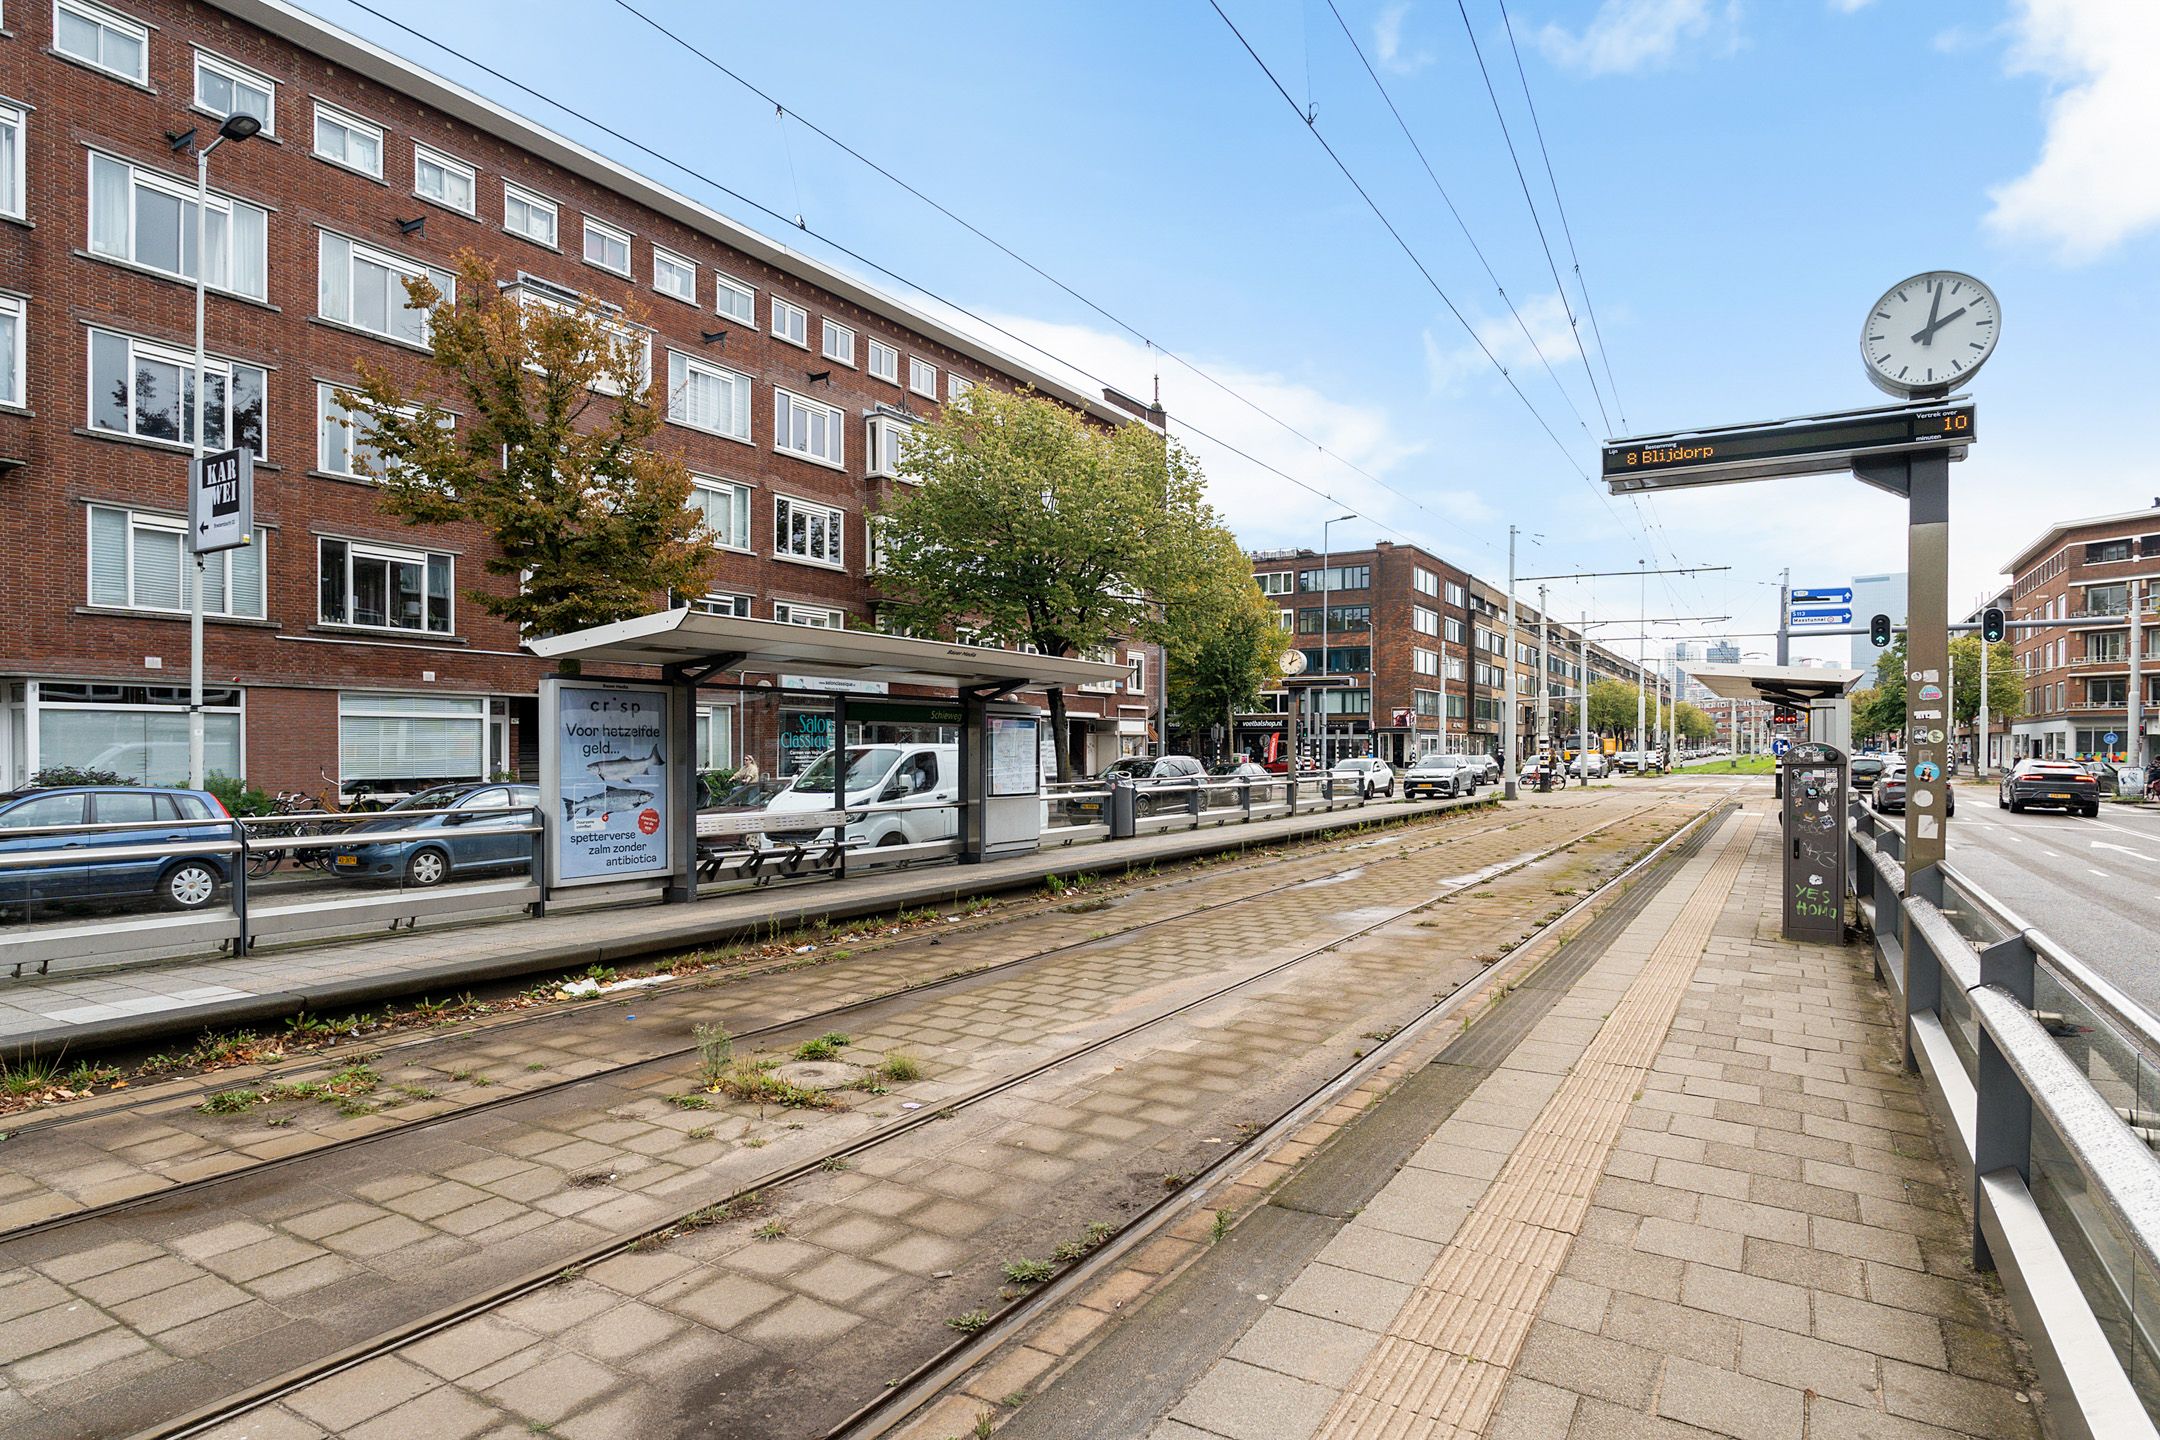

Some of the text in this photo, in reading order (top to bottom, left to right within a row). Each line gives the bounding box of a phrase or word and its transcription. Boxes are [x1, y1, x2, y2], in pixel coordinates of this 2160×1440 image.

[1944, 415, 1967, 431] 10
[1915, 434, 1942, 442] minuten
[1627, 447, 1714, 465] 8 Blijdorp
[206, 458, 237, 486] KAR
[212, 480, 237, 506] WEI
[799, 714, 833, 733] Salon
[930, 710, 963, 722] Schieweg
[1242, 719, 1283, 728] voetbalshop.nl
[565, 722, 661, 738] Voor hetzelfde
[582, 741, 620, 758] geld...
[570, 832, 636, 845] spetterverse
[588, 842, 648, 856] zalm zonder
[605, 854, 658, 867] antibiotica
[1795, 883, 1830, 905] YES
